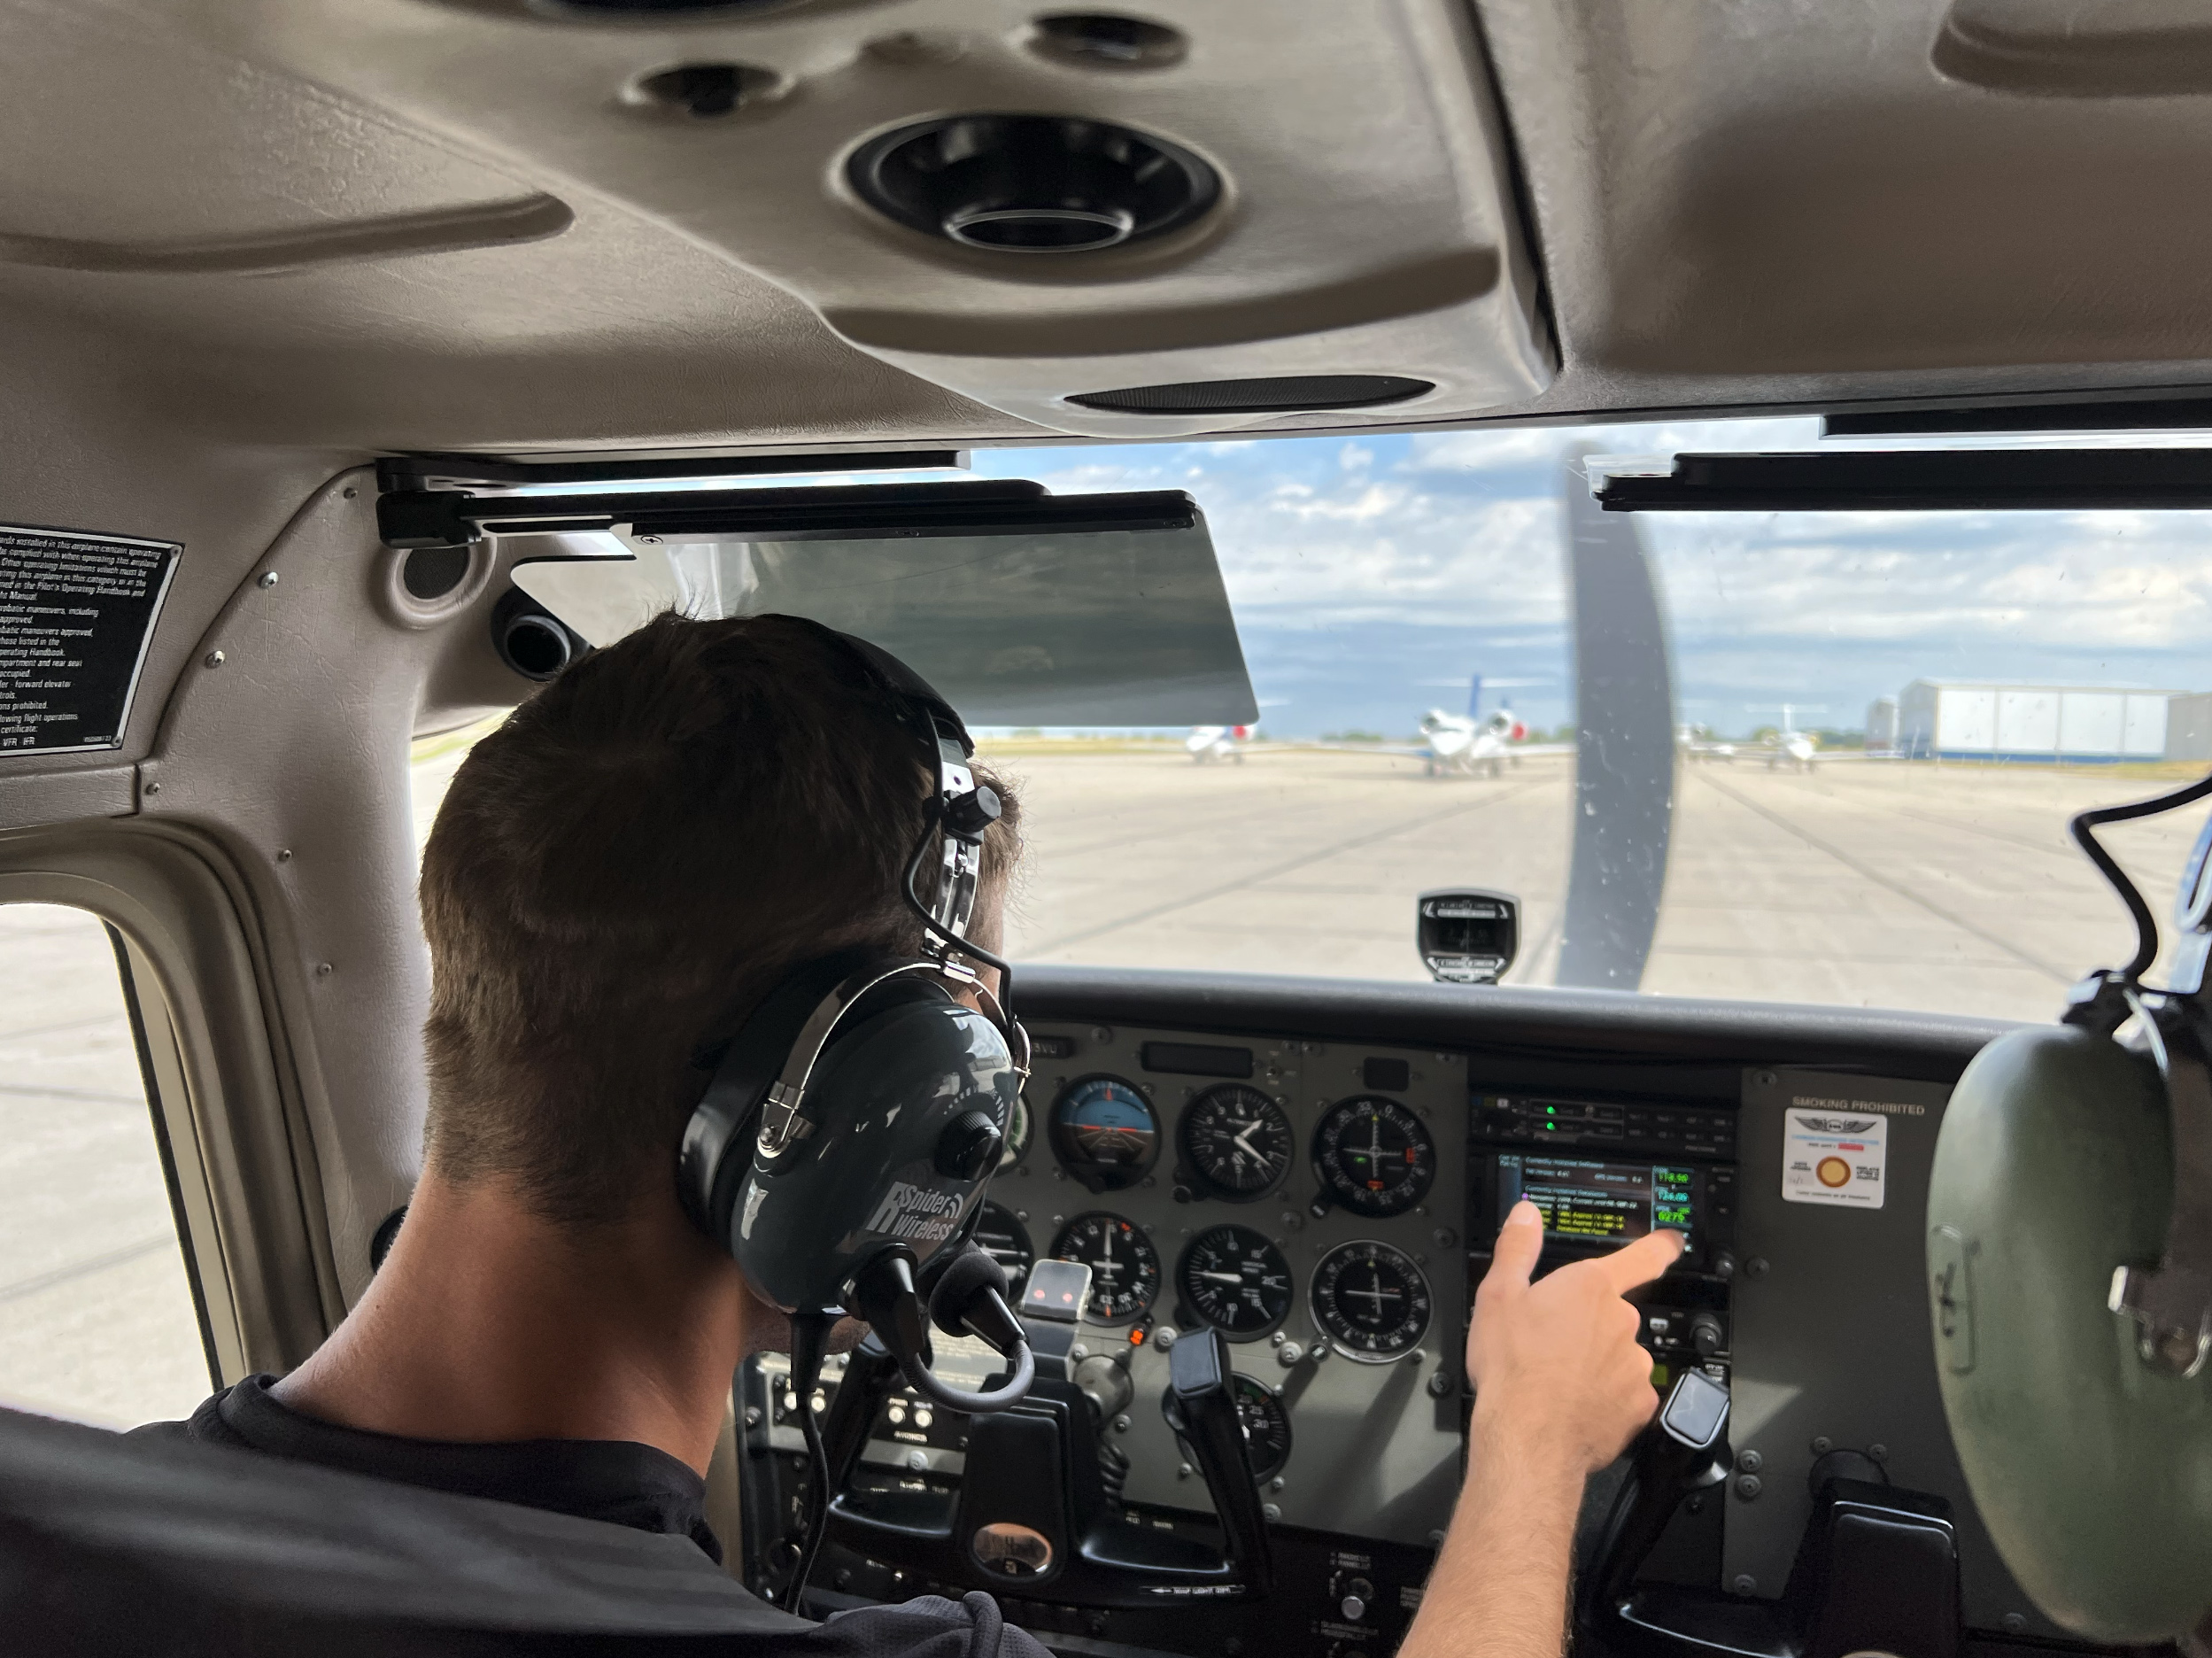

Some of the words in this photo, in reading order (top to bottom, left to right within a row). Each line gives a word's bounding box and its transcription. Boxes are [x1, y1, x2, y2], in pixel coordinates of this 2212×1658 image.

[81, 554, 115, 565] operating
[128, 548, 161, 560] operating
[24, 561, 58, 571] operating
[62, 584, 96, 595] Operating
[23, 713, 43, 724] flight
[4, 737, 18, 747] VFR
[1792, 1096, 1849, 1110] SMOKING
[1852, 1099, 1925, 1116] PROHIBITED
[898, 1184, 952, 1214] Spider
[891, 1213, 955, 1241] Wireless
[1253, 1418, 1270, 1429] 30
